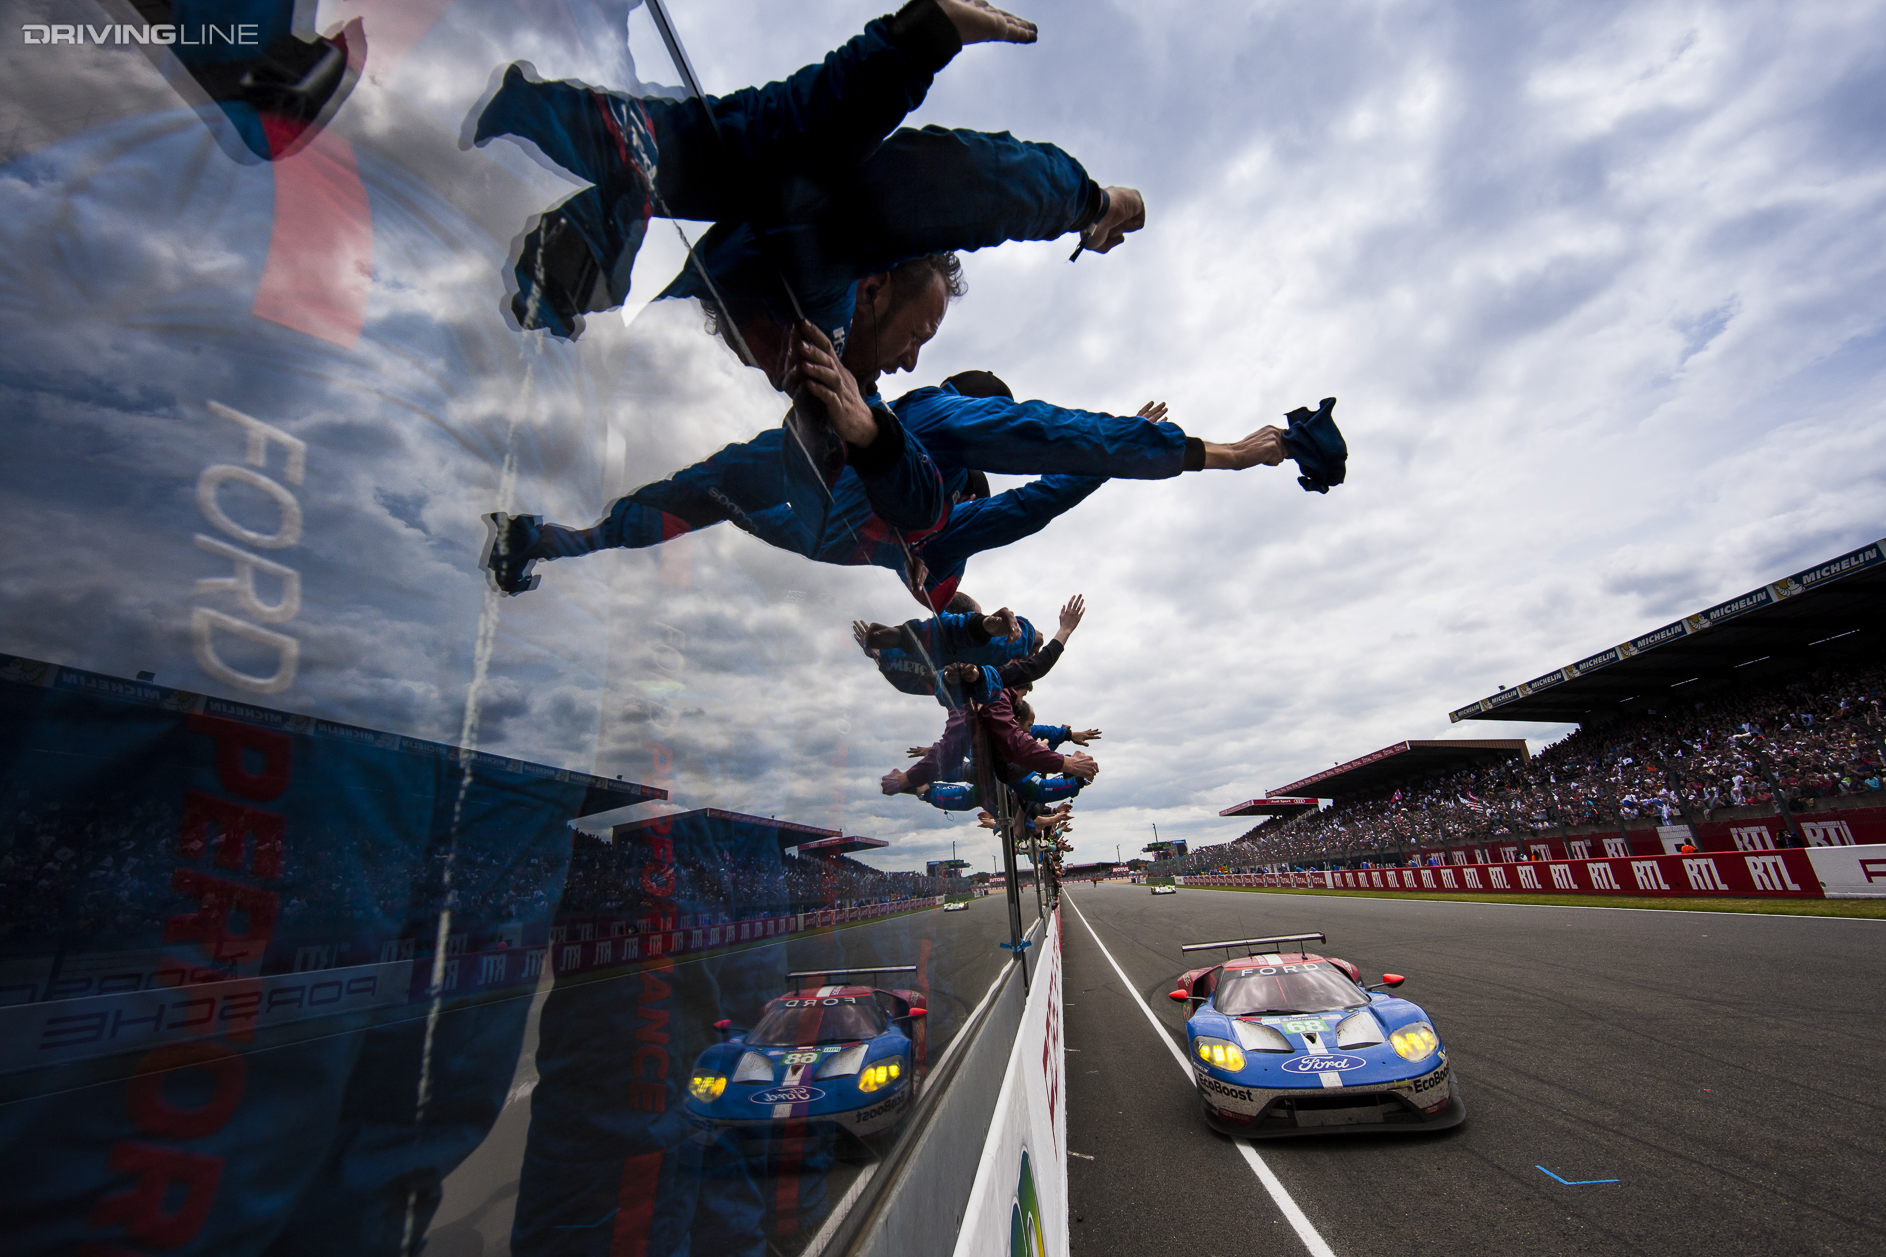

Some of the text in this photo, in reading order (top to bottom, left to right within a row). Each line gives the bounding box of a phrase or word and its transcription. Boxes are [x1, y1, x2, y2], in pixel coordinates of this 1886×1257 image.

[193, 400, 307, 694] FORD
[1802, 548, 1878, 584] MICHELIN
[1710, 591, 1767, 619] MICHELIN
[1637, 624, 1682, 648] MICHELIN
[1579, 651, 1616, 670] MICHELIN
[1531, 672, 1562, 689] MICHELIN
[1491, 689, 1517, 703] MICHELIN
[1311, 875, 1325, 884] TOTAL
[1403, 870, 1417, 888] RTL
[1420, 870, 1437, 888] RTL
[1440, 869, 1459, 888] RTL
[1463, 868, 1483, 889] RTL
[1488, 867, 1511, 889] RTL
[1516, 865, 1542, 889] RTL
[1549, 864, 1579, 889] RTL
[1586, 862, 1621, 889] RTL
[1631, 860, 1671, 890] RTL
[1682, 858, 1729, 890] RTL
[1744, 855, 1801, 891] RTL
[1241, 964, 1319, 976] FORD
[78, 711, 294, 1257] PERFOR
[1286, 1020, 1324, 1033] 68
[1298, 1056, 1349, 1071] Ford
[1199, 1073, 1254, 1102] EcoBoost
